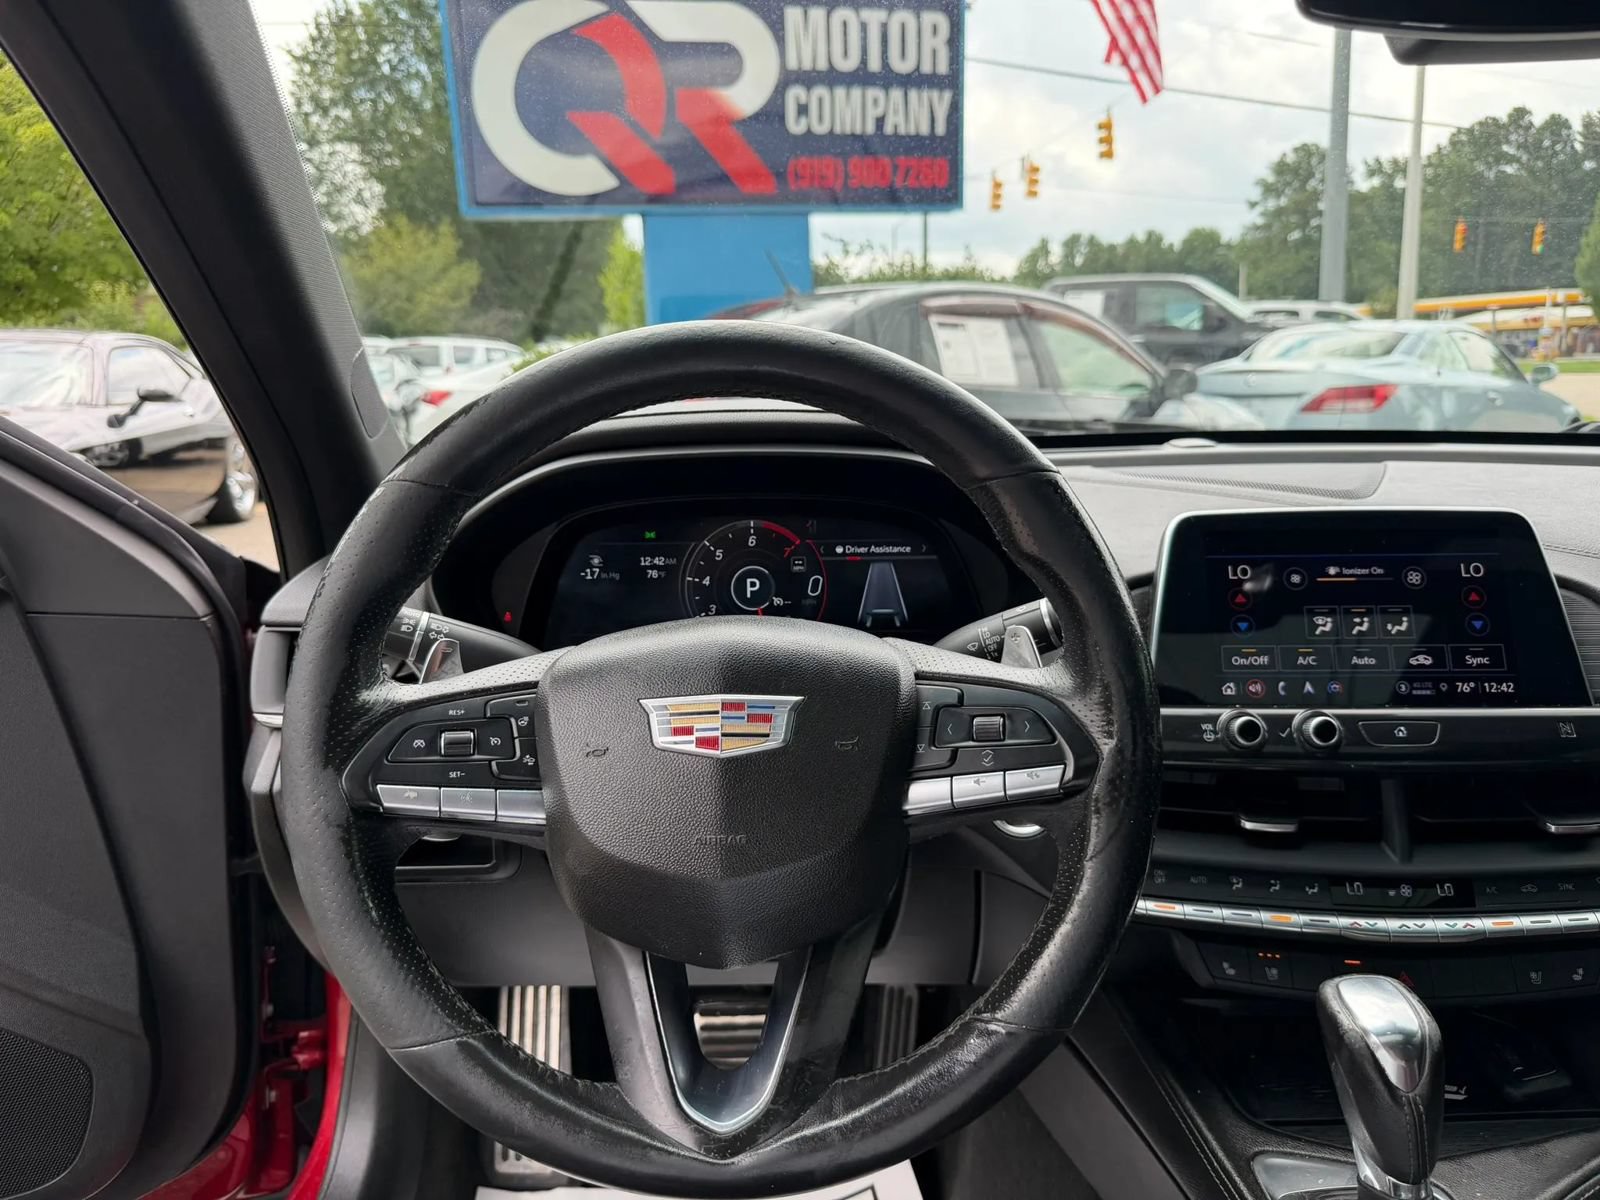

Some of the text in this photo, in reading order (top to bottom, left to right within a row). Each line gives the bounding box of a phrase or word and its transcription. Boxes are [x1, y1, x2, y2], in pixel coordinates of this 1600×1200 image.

[784, 6, 950, 75] MOTOR
[785, 85, 952, 138] COMPANY
[787, 155, 845, 192] (919)
[748, 535, 757, 547] 6
[715, 549, 724, 561] 5
[783, 547, 792, 559] 7
[845, 544, 912, 554] Driver Assistance
[580, 568, 600, 580] -17
[1228, 565, 1250, 580] LO
[1342, 566, 1384, 575] Ionizer On
[1461, 563, 1484, 578] LO
[702, 576, 711, 587] 4
[808, 575, 823, 597] 0
[746, 578, 760, 598] P
[708, 604, 717, 615] 3
[985, 635, 1001, 645] AUTO
[1231, 655, 1269, 666] On/Off
[1297, 655, 1317, 666] A/C
[1351, 655, 1376, 666] Auto
[1465, 654, 1490, 668] Sync
[1456, 682, 1475, 693] 76°
[1484, 682, 1515, 693] 12:42
[694, 834, 748, 846] AIRBAG
[1346, 882, 1363, 896] LO
[1436, 883, 1454, 897] LO
